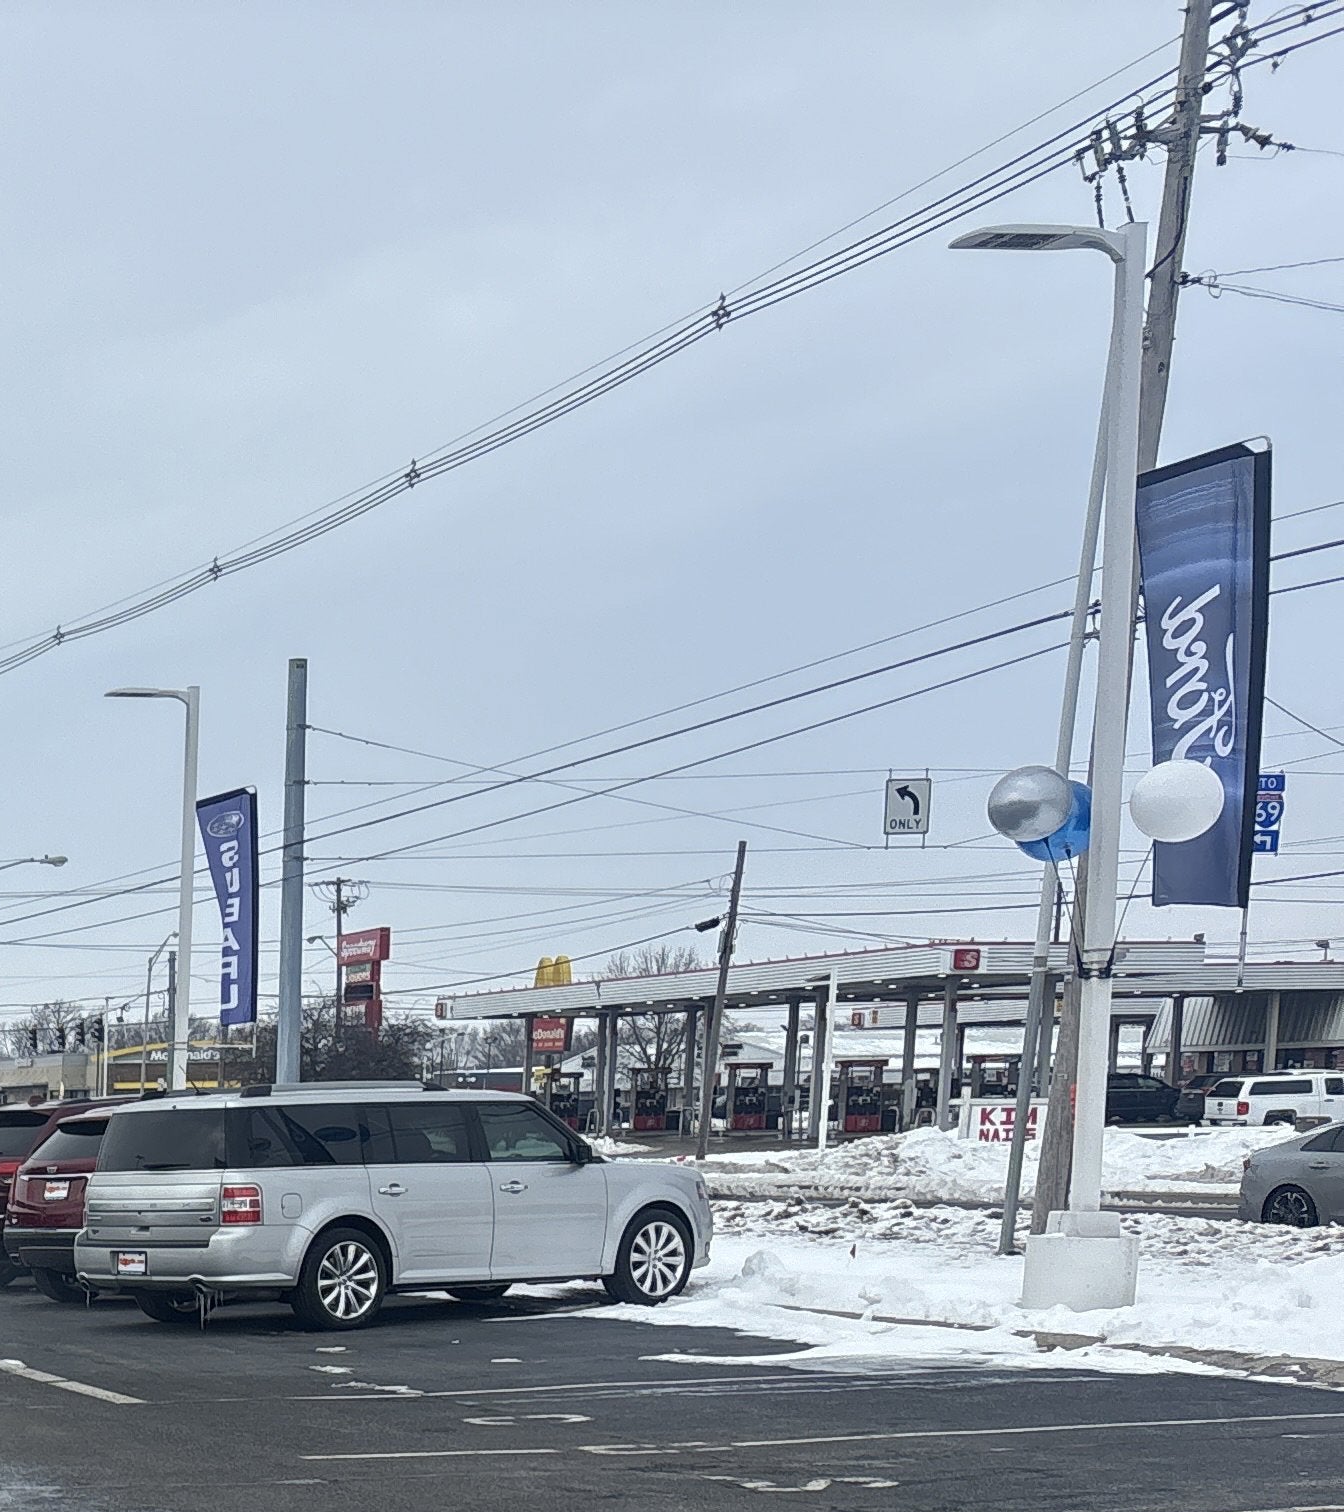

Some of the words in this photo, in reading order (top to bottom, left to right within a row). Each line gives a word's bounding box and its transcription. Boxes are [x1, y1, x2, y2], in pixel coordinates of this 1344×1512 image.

[1259, 777, 1277, 789] TO
[1255, 801, 1281, 822] 69
[889, 818, 922, 830] ONLY
[150, 1049, 220, 1060] Mcnald's
[978, 1127, 1037, 1142] NAIS
